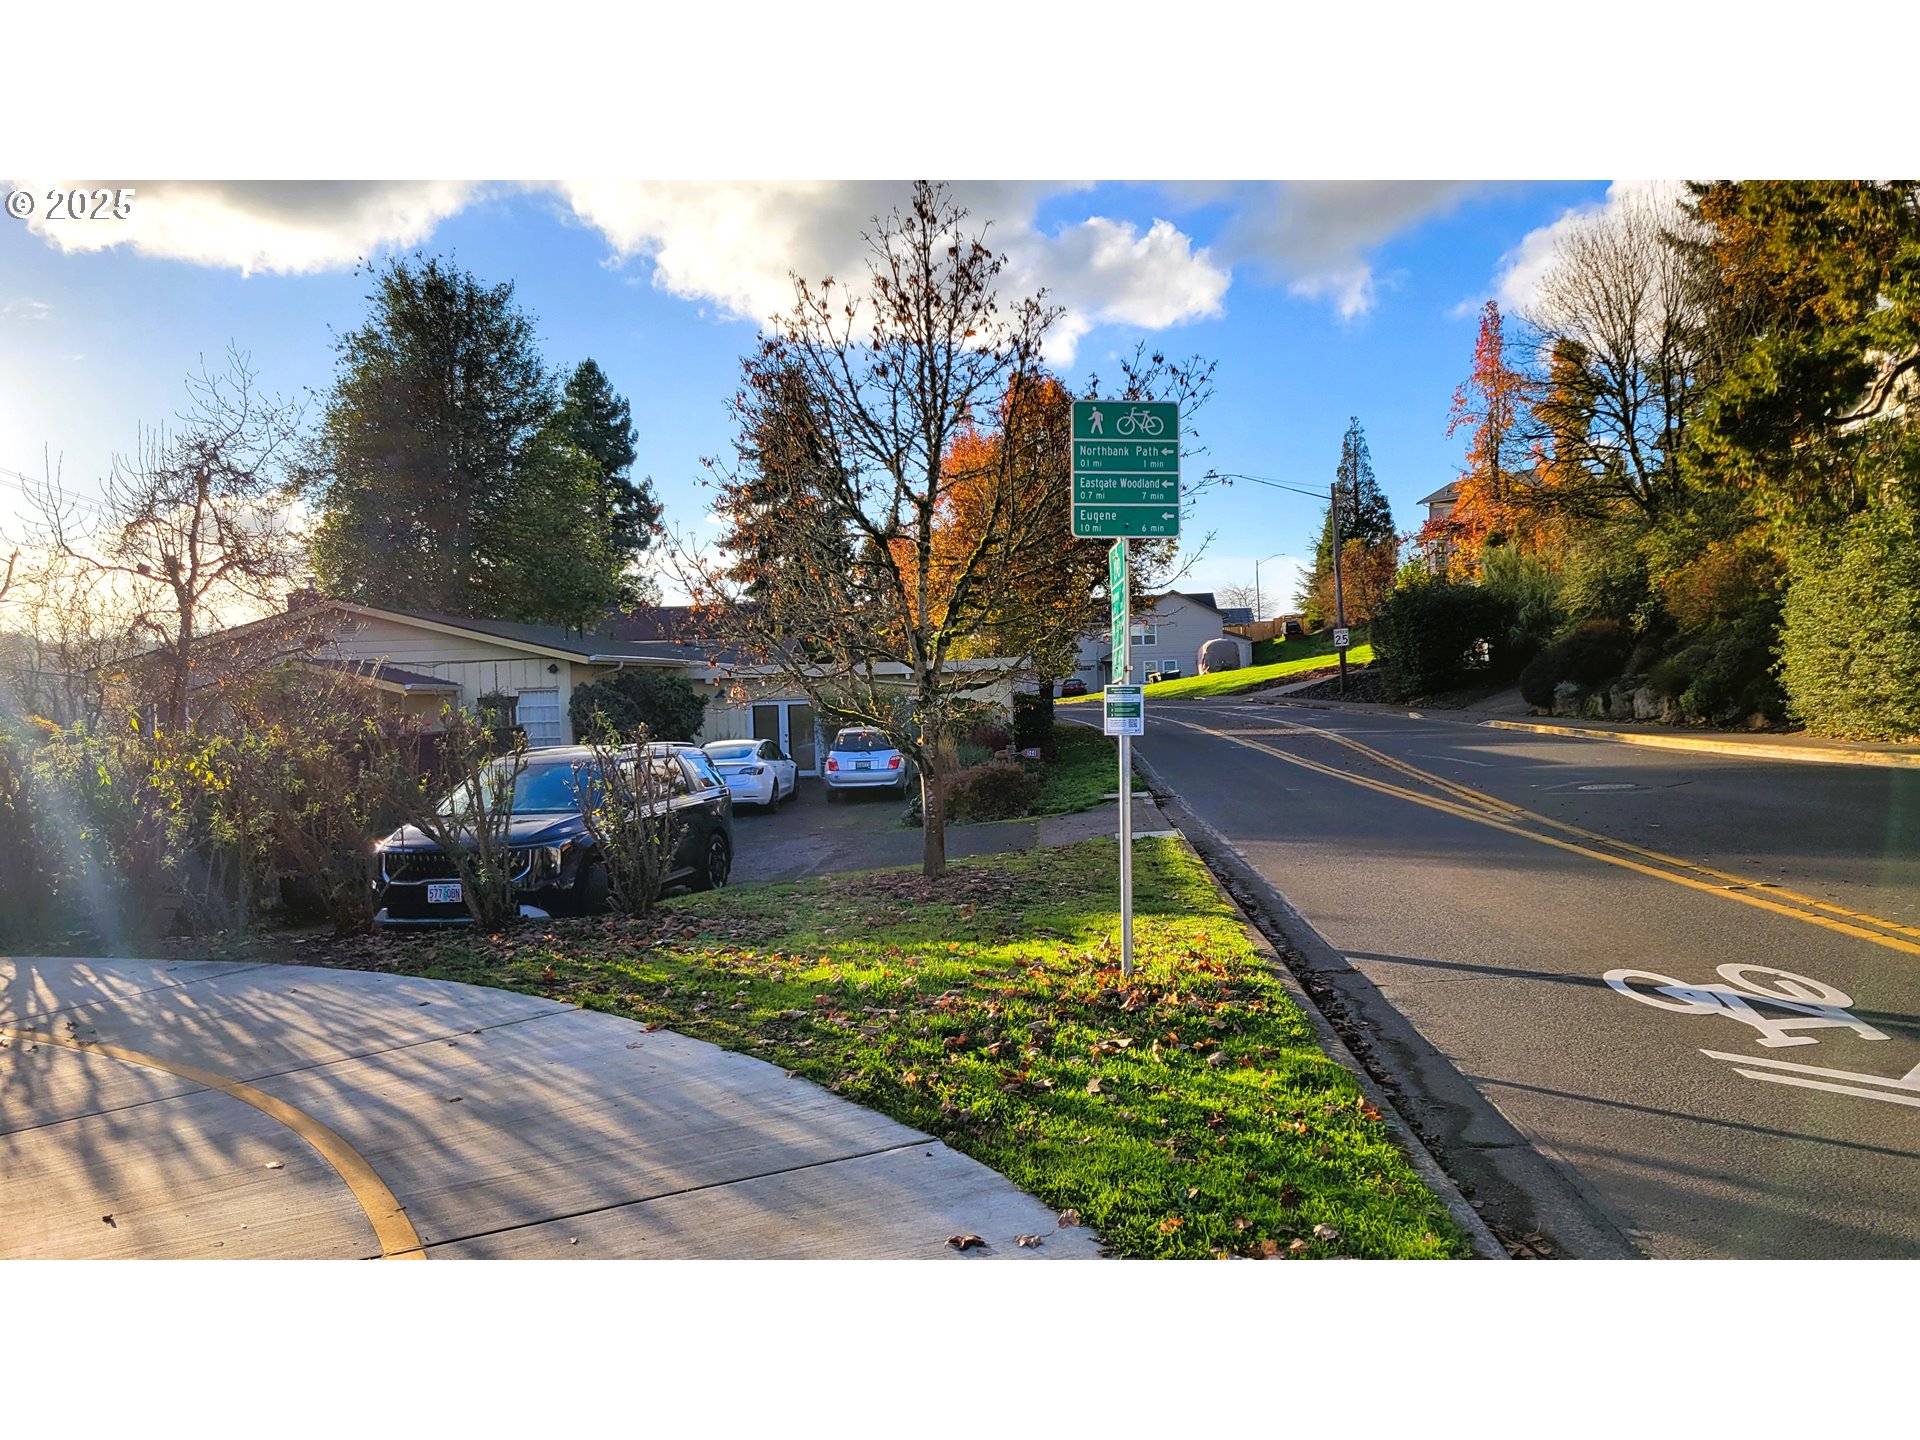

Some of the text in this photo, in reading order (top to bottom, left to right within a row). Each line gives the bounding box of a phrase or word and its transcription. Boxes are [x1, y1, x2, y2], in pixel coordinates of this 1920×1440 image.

[1080, 445, 1159, 457] Northbank Path
[1093, 459, 1102, 467] mi
[1143, 459, 1147, 468] 1
[1150, 459, 1164, 468] min
[1080, 477, 1160, 491] Eastgate Woodland
[1080, 491, 1164, 500] 0.7 mi 7 min
[1080, 509, 1117, 523] Eugene
[1092, 524, 1102, 532] mi
[1141, 524, 1147, 532] 6
[1150, 524, 1165, 532] min
[1335, 634, 1349, 645] 25
[429, 888, 443, 899] 577
